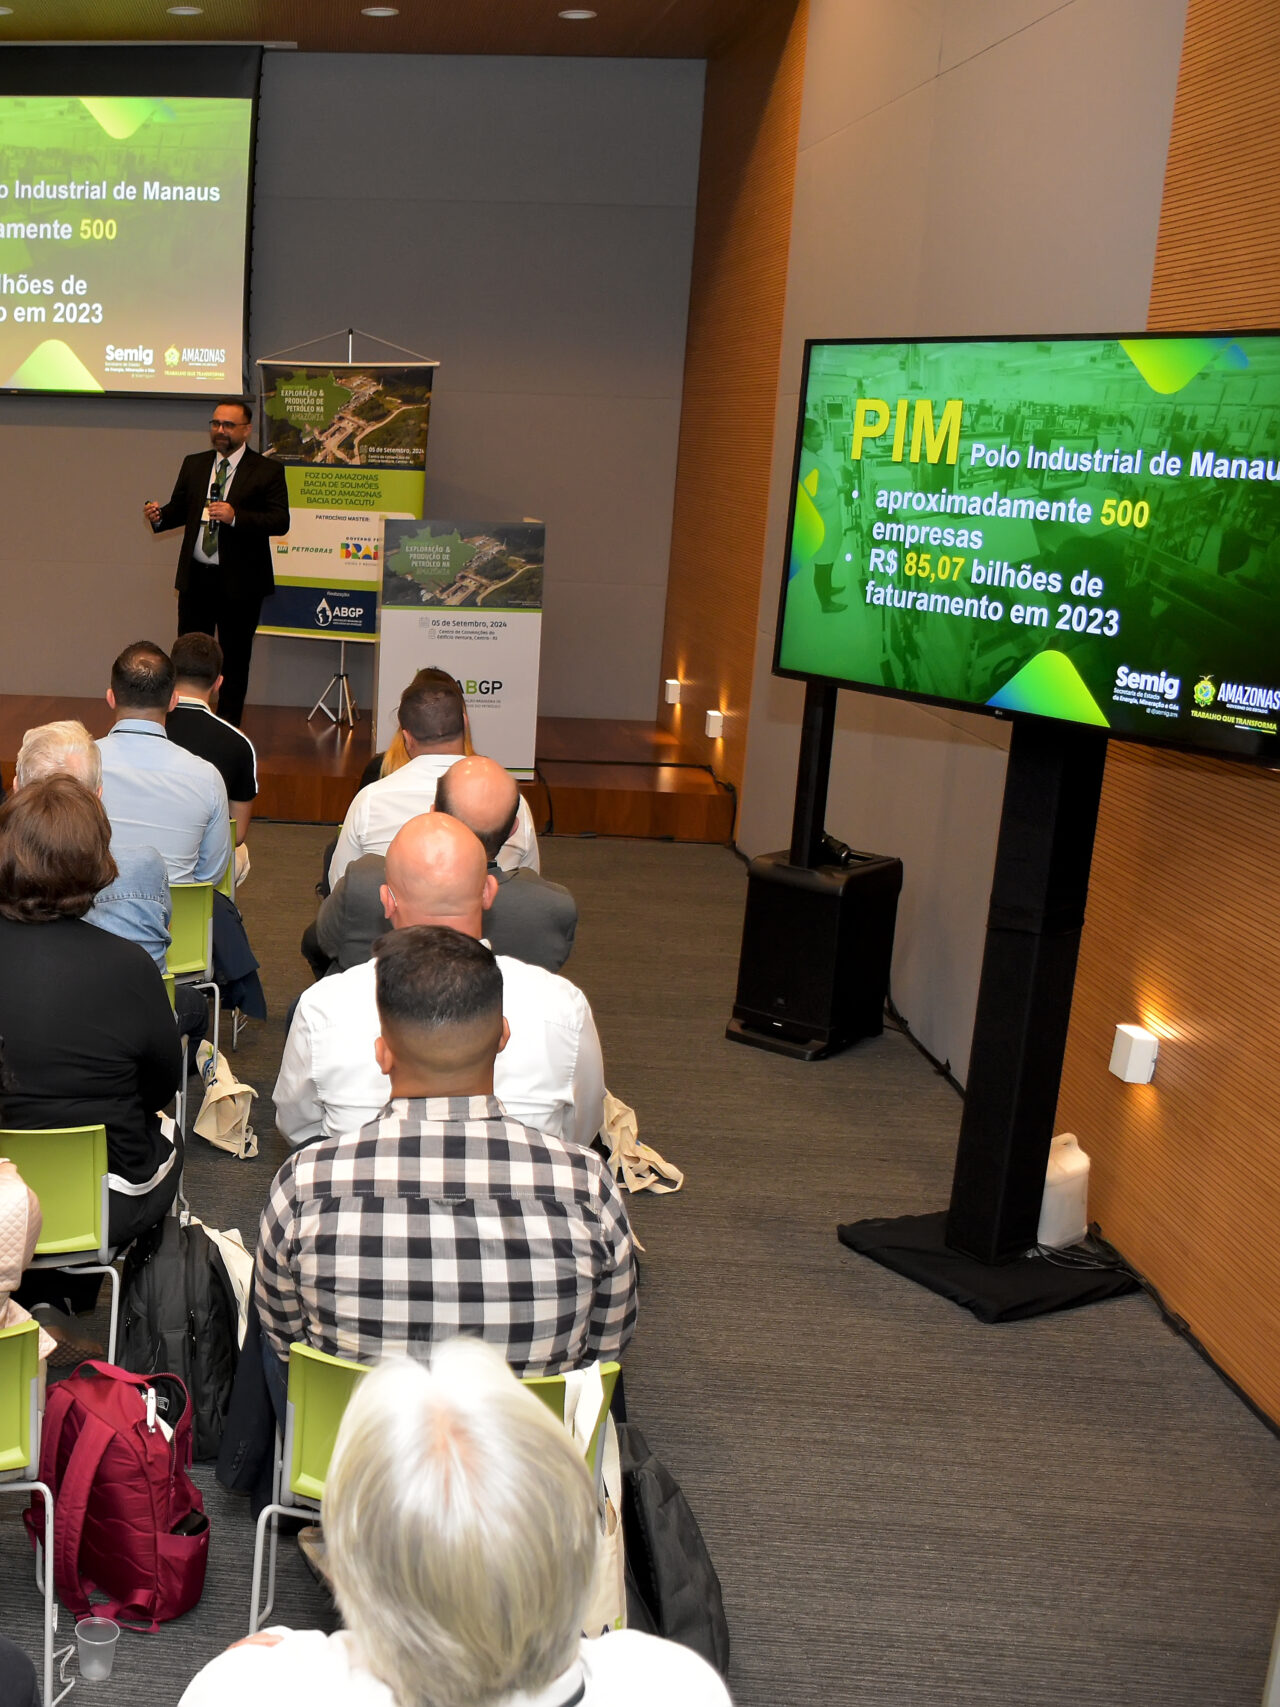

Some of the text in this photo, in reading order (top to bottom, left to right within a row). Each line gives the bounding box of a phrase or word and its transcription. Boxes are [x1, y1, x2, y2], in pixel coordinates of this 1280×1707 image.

[14, 181, 107, 200] Industrial
[113, 181, 137, 200] de
[143, 182, 221, 201] Manaus
[79, 219, 117, 240] 500
[61, 275, 87, 296] de
[13, 306, 47, 323] em
[52, 302, 104, 324] 2023
[105, 344, 154, 365] Semig
[181, 348, 225, 363] AMAZONAS
[281, 389, 317, 397] EXPLORAÇÃO
[285, 397, 314, 405] PRODUÇÃO
[287, 404, 314, 412] PETRÓLEO
[850, 397, 963, 465] PIM
[969, 443, 1280, 482] Polo Industrial de Manau
[334, 473, 378, 481] AMAZONAS
[340, 481, 379, 490] SOLIMÕES
[337, 490, 382, 498] AMAZONAS
[875, 488, 1150, 529] aproximadamente 500
[872, 522, 983, 550] empresas
[291, 546, 333, 554] PETROBRAS
[869, 548, 1103, 598] R$ 85,07 bilhões de
[333, 606, 363, 618] ABGP
[865, 581, 1120, 637] faturamento em 2023
[452, 620, 488, 628] Setembro,
[1115, 666, 1180, 699] Semig
[1217, 682, 1280, 710] AMAZONAS
[1191, 710, 1277, 730] TRABALHO QUE TRANSFORMA
